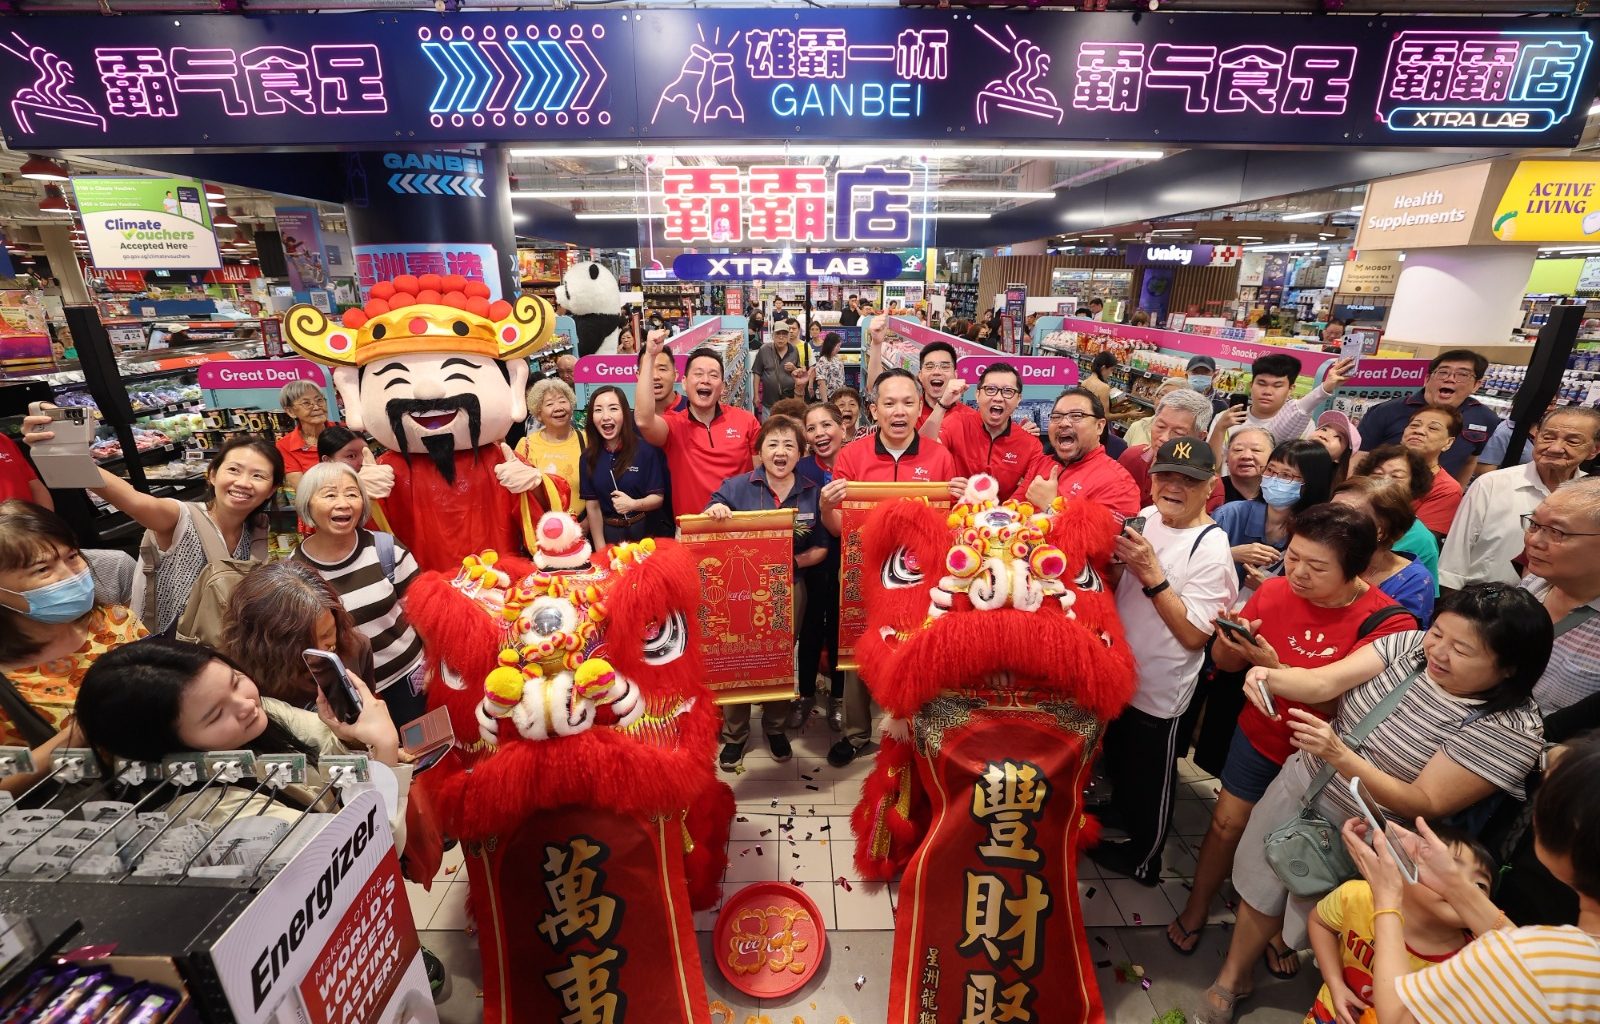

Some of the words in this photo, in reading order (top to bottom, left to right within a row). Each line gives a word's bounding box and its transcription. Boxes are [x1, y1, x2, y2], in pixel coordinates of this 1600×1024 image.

[745, 29, 948, 79] 雄霸一杯
[95, 44, 388, 117] 霸气食足
[1073, 42, 1358, 115] 霸气食足
[1390, 40, 1582, 101] 霸霸店
[771, 83, 922, 117] GANBEI
[1413, 112, 1476, 128] XTRA
[1482, 112, 1530, 128] LAB
[383, 153, 484, 175] GANBEI
[1394, 190, 1443, 210] Health
[1529, 183, 1596, 197] ACTIVE
[663, 165, 914, 243] 霸霸店
[1526, 200, 1587, 214] LIVING
[105, 218, 162, 231] Climate
[1368, 208, 1465, 231] Supplements
[120, 242, 164, 251] Accepted
[166, 242, 188, 250] Here
[1147, 245, 1192, 265] Unity
[707, 257, 797, 276] XTRA
[806, 257, 869, 276] LAB
[185, 356, 212, 365] Organic
[1231, 345, 1258, 360] Snacks
[220, 368, 263, 382] Great
[267, 368, 300, 381] Deal
[595, 363, 639, 376] Great
[1022, 365, 1056, 377] Deal
[1356, 367, 1388, 379] reat
[1390, 367, 1424, 379] Deal
[251, 804, 377, 1014] Energizer
[315, 924, 352, 985] Makers
[353, 904, 364, 922] of
[366, 875, 382, 902] the
[318, 873, 396, 1001] WORLD'S
[325, 899, 396, 1023] LONGEST
[338, 927, 395, 1024] ASTING
[351, 936, 402, 1024] TTERY
